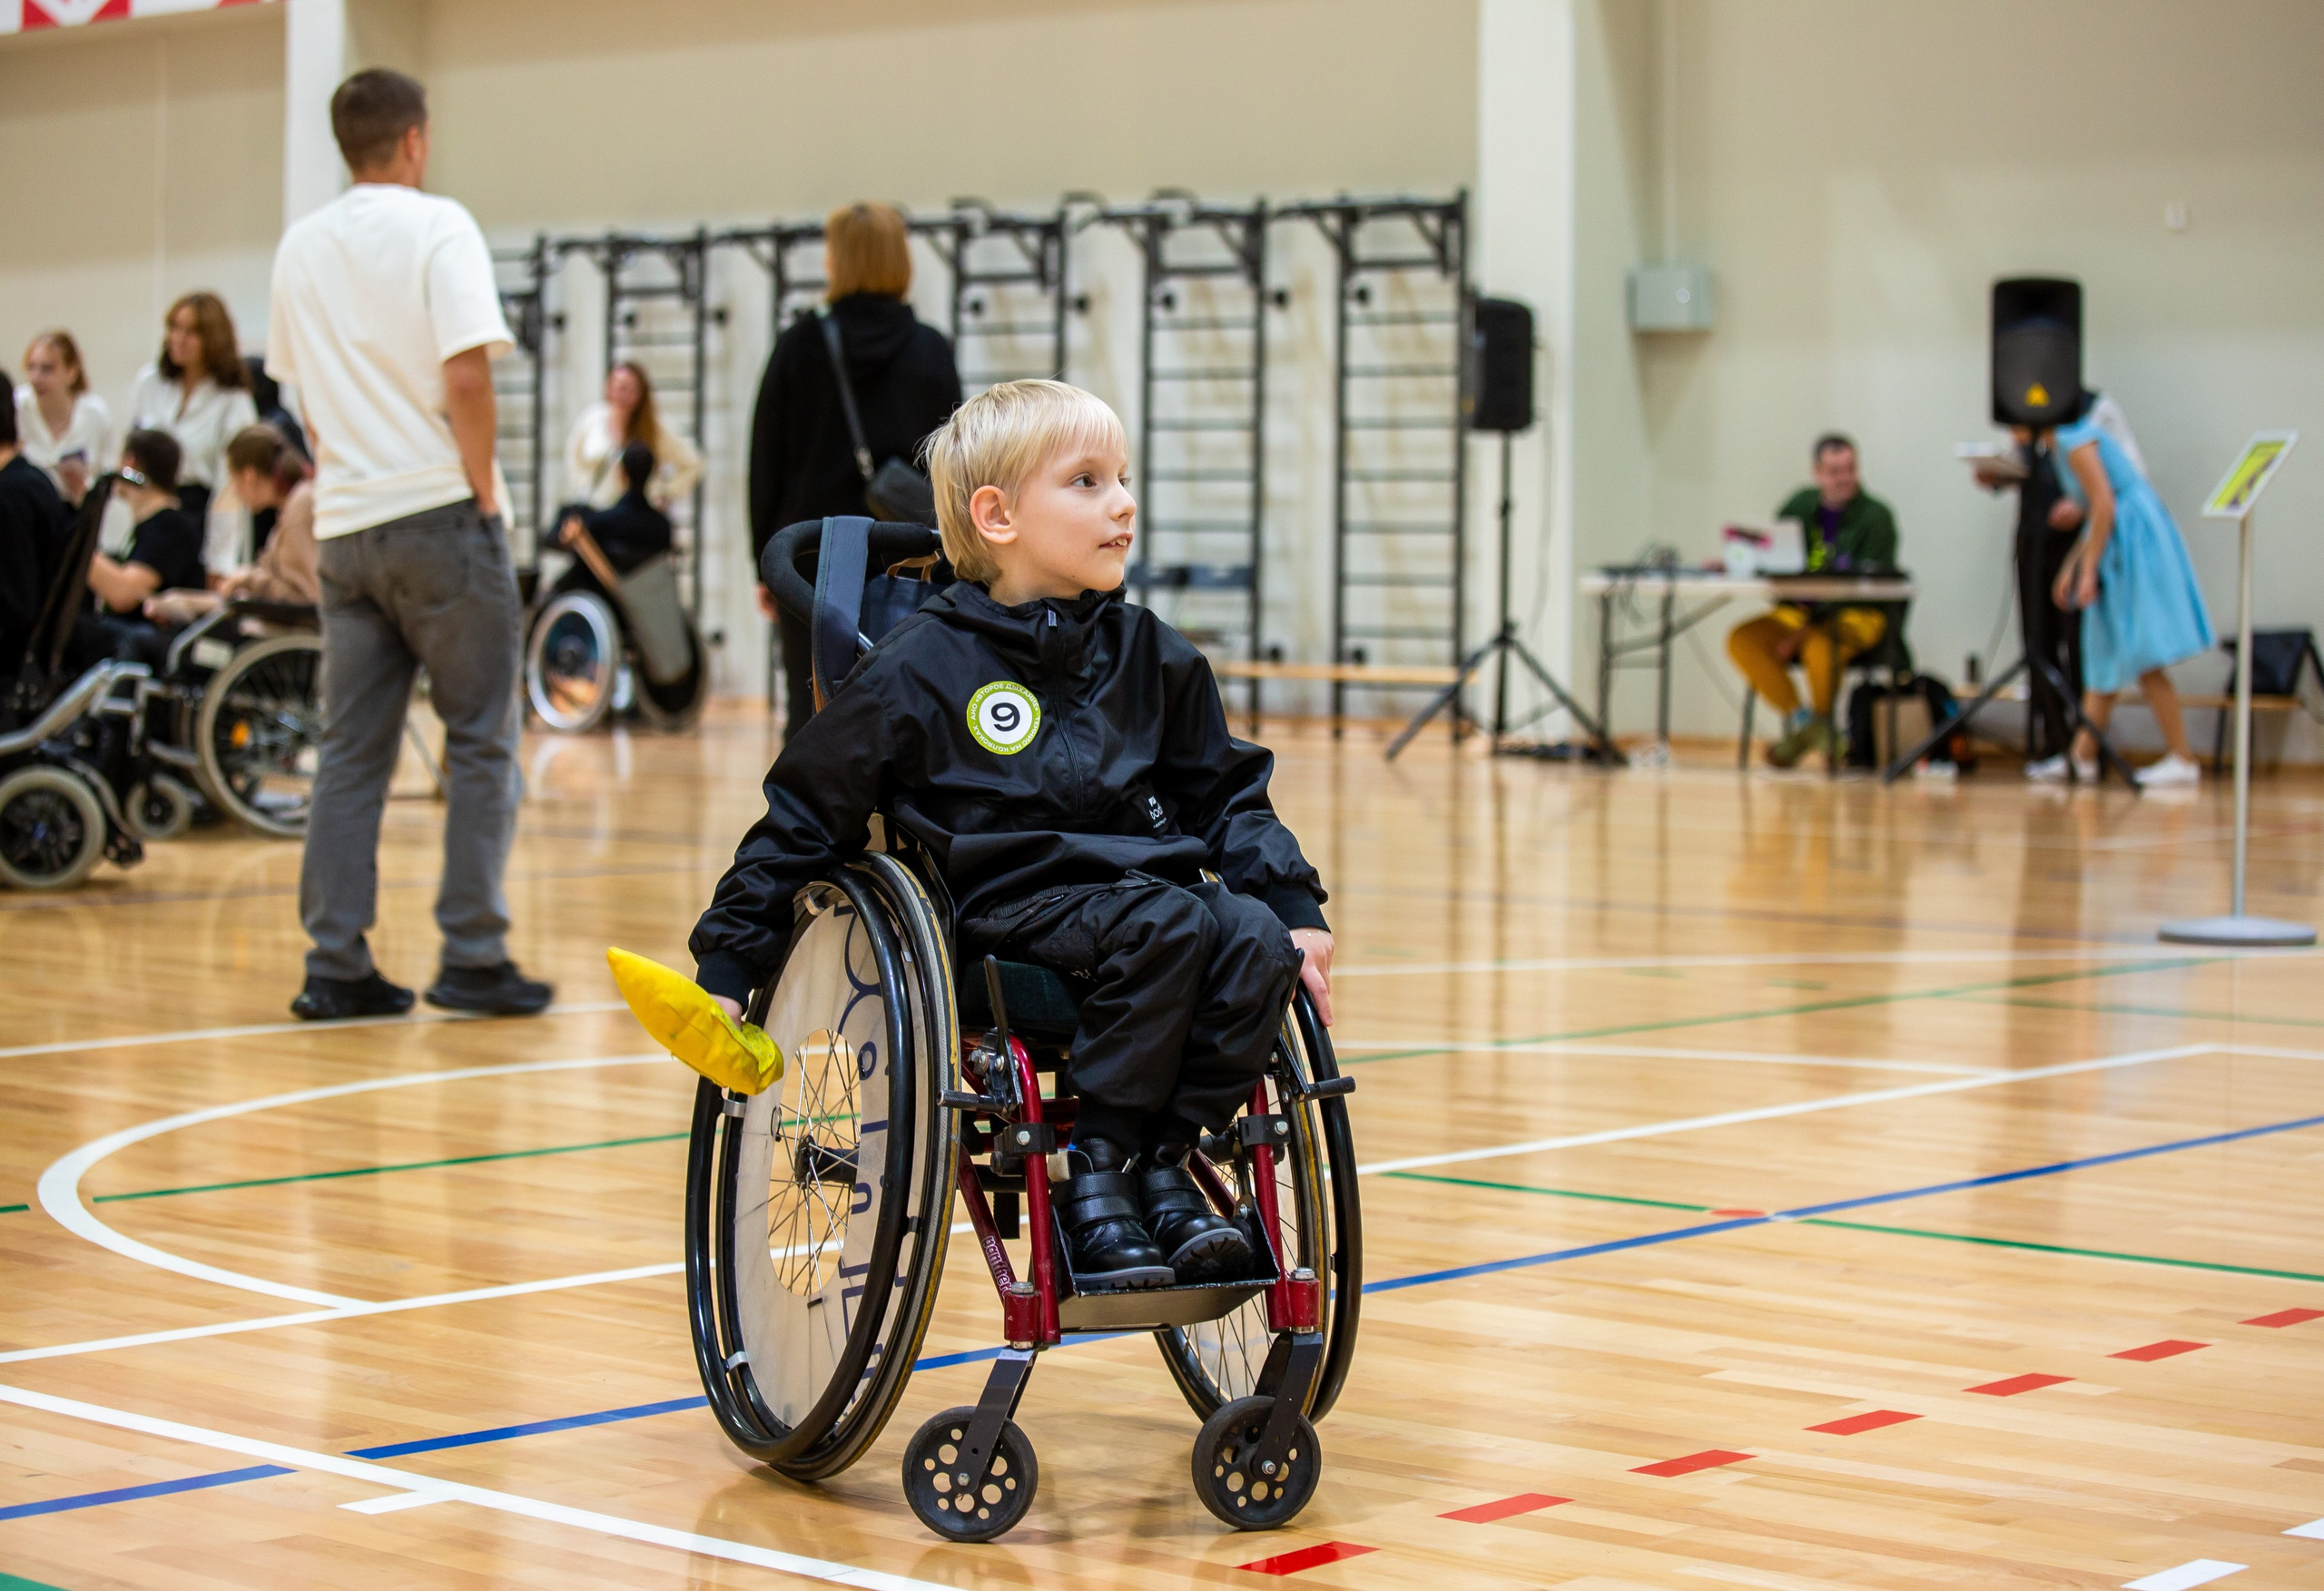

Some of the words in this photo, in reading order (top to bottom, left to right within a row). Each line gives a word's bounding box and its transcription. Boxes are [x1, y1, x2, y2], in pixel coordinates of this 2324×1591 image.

[975, 683, 1004, 702] «ВТОРОЕ
[1005, 683, 1039, 712] ДЫХАНИЕ»
[990, 702, 1020, 732] 9
[1021, 716, 1039, 745] ТЕННИС
[973, 725, 1009, 752] КОЛЯСКАХ
[1010, 743, 1021, 751] НА
